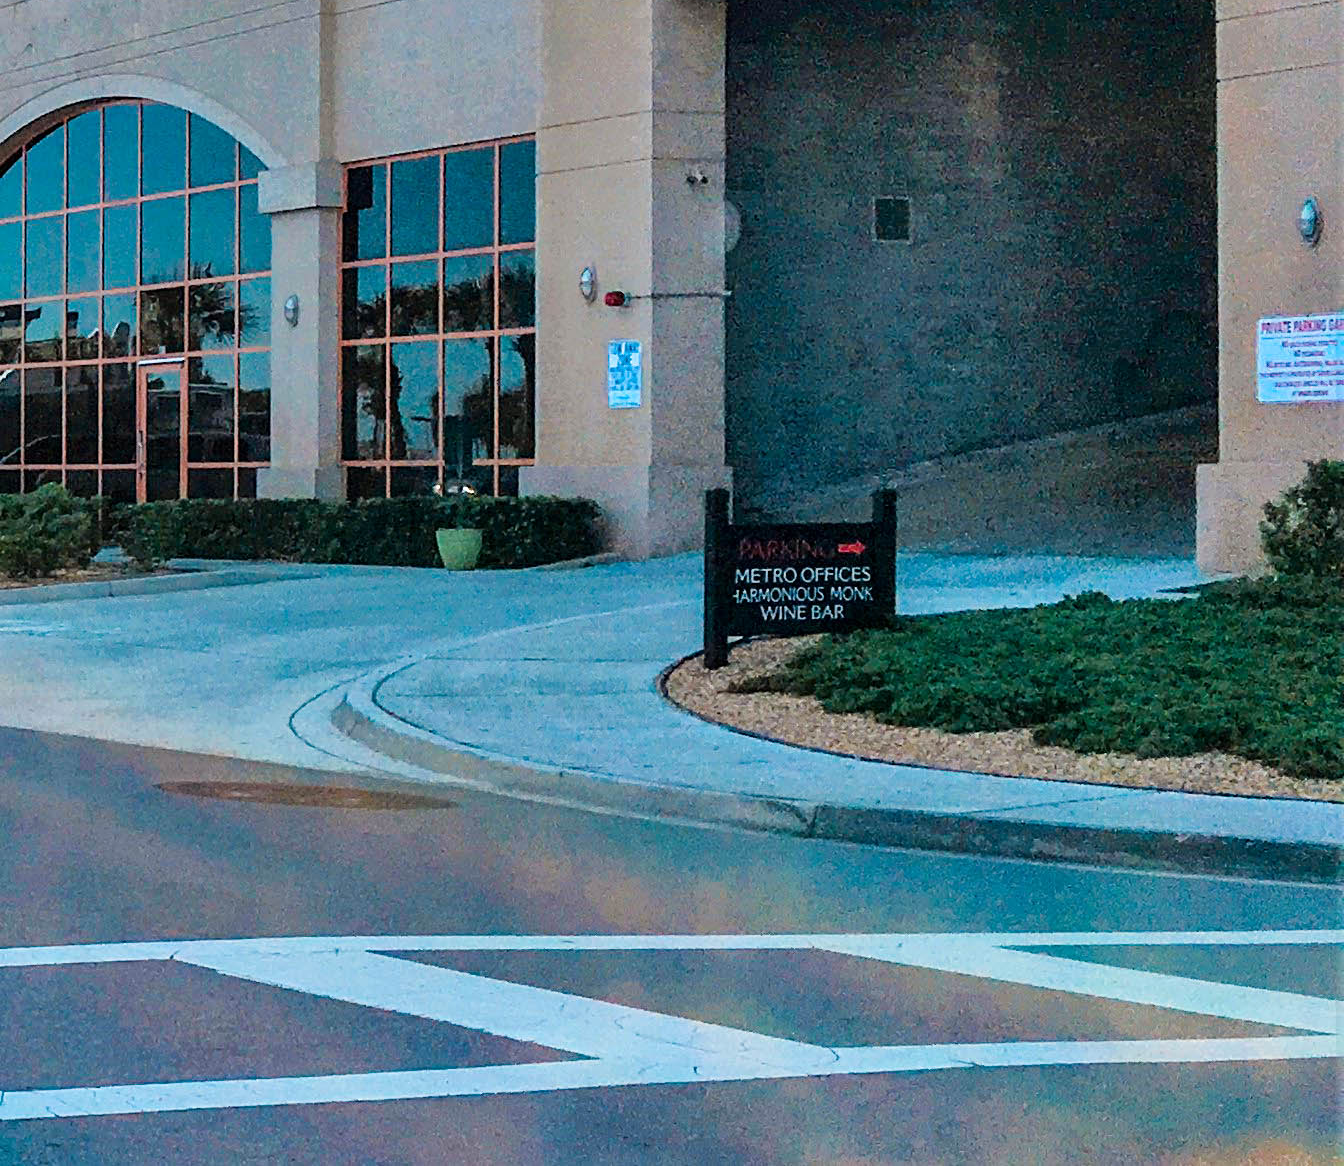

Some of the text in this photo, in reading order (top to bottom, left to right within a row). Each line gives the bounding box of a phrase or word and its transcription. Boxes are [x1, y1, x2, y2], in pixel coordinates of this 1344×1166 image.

[735, 566, 871, 584] METRO OFFICES
[830, 586, 874, 601] MONK
[760, 605, 845, 621] WINE BAR
